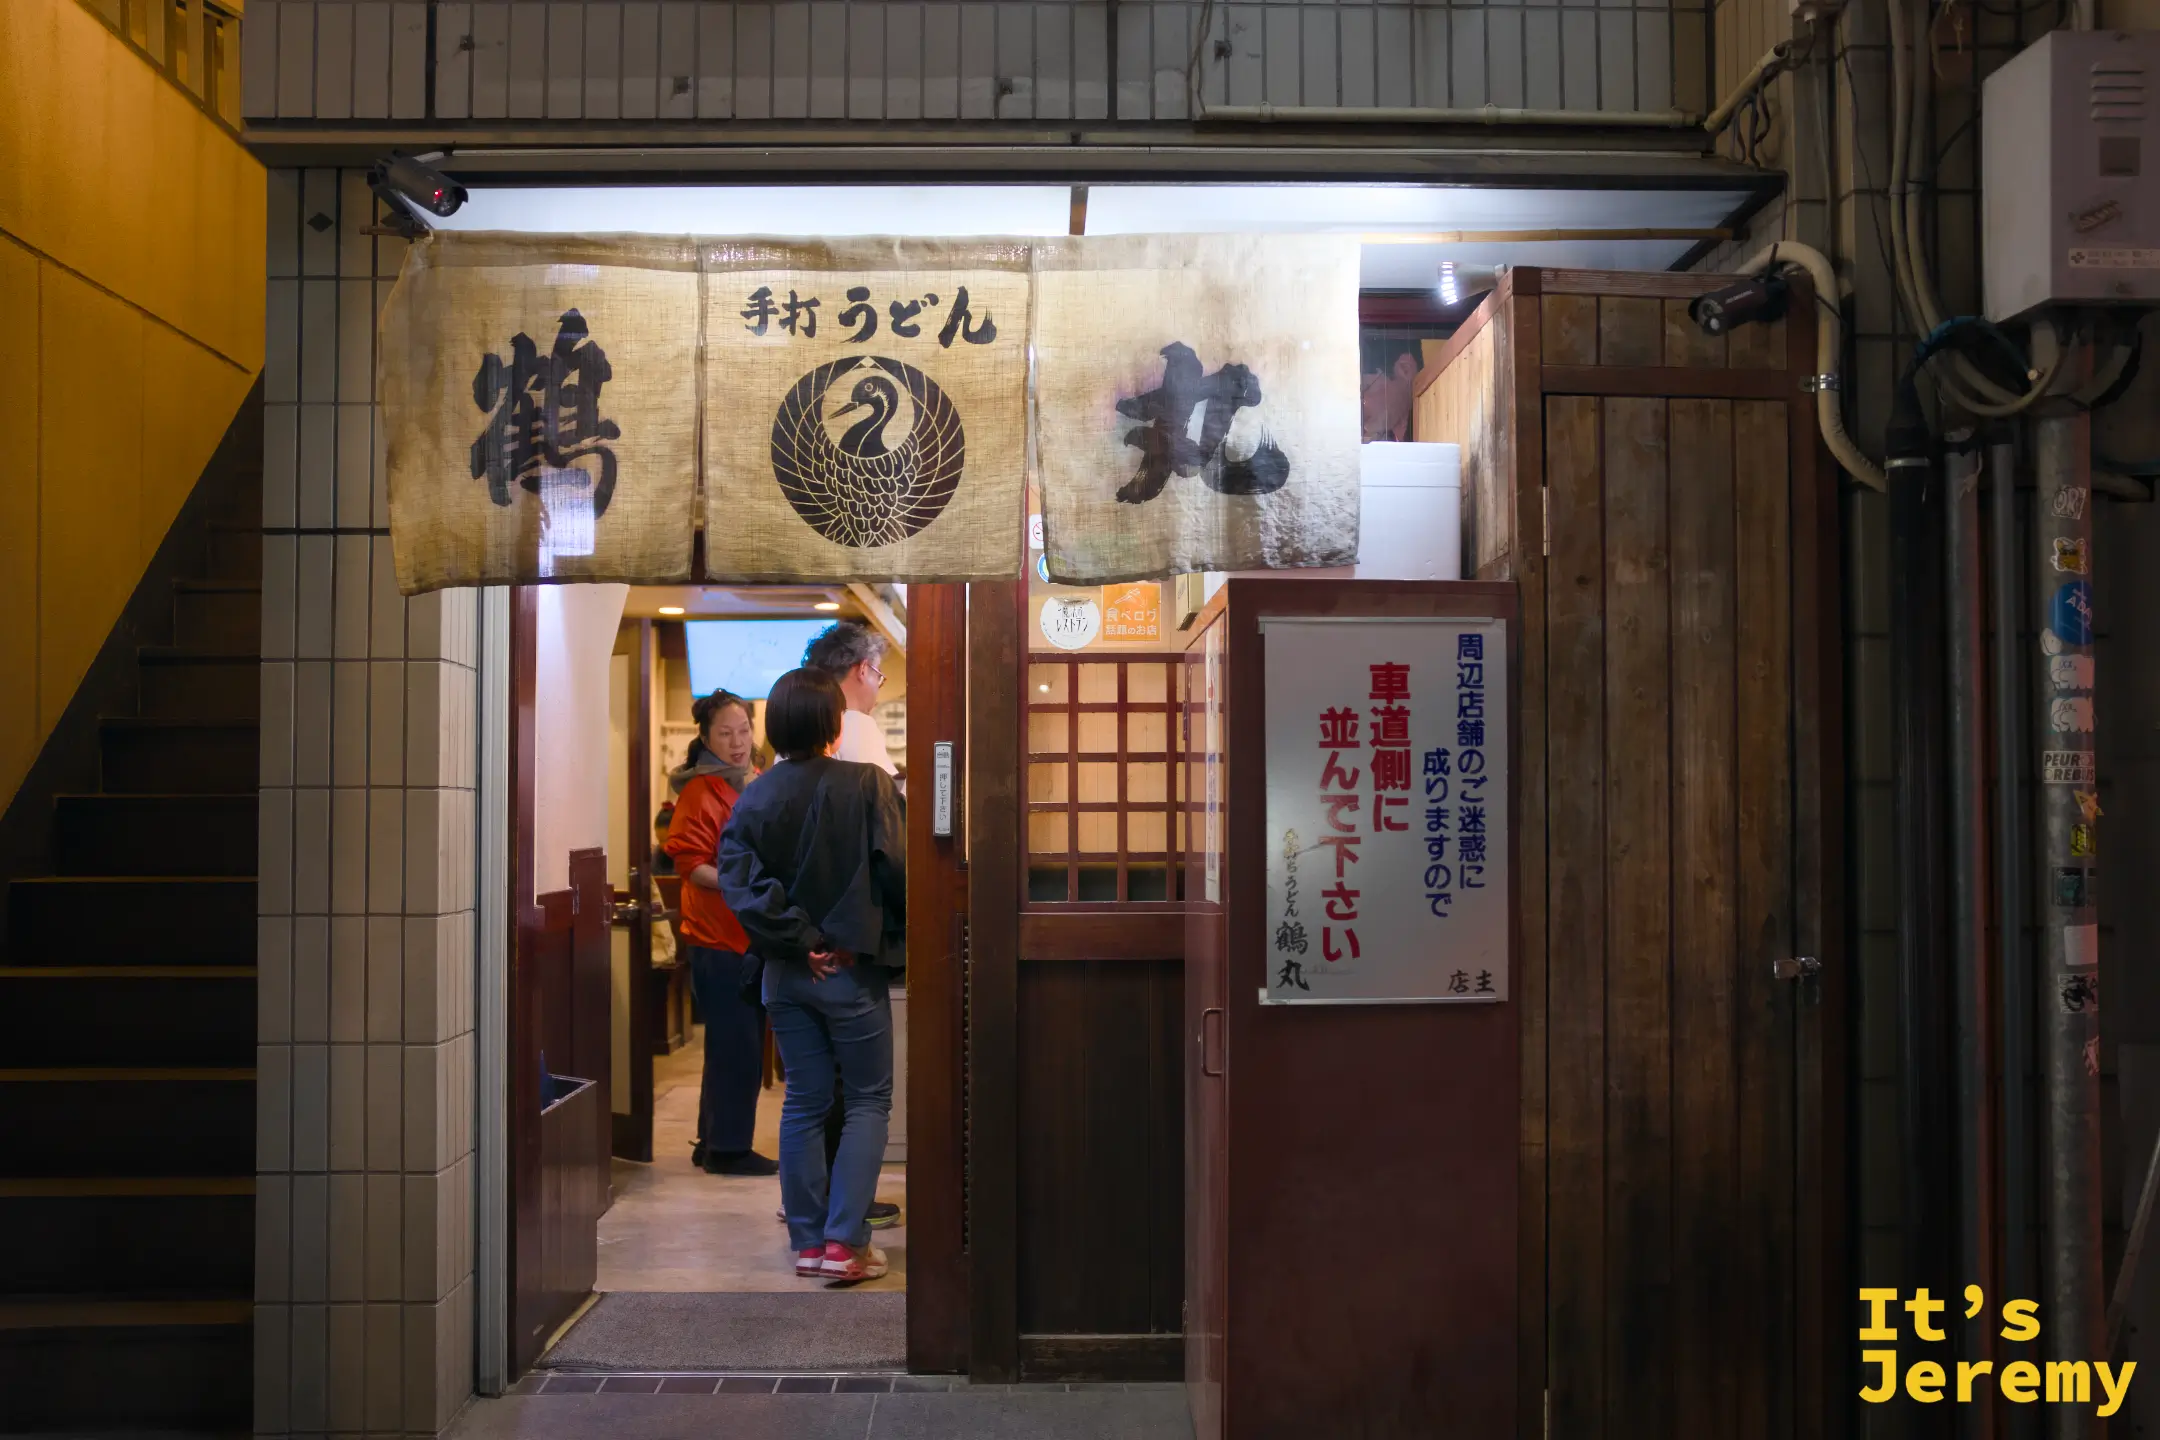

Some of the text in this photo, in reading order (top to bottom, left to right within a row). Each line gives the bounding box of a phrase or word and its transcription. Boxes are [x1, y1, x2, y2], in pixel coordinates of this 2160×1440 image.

[740, 285, 997, 349] 手打うどん
[471, 307, 621, 520] 鶴
[1115, 341, 1291, 505] 丸
[1105, 607, 1157, 622] 食べログ
[1105, 624, 1157, 636] 話題のお店
[1369, 661, 1412, 832] 車道側に
[1456, 633, 1488, 890] 周辺店舗のご迷惑に
[1318, 706, 1361, 962] 並んで下さい
[1423, 748, 1453, 918] 成りますので
[1274, 921, 1310, 991] 鶴丸
[1447, 969, 1496, 994] 店主
